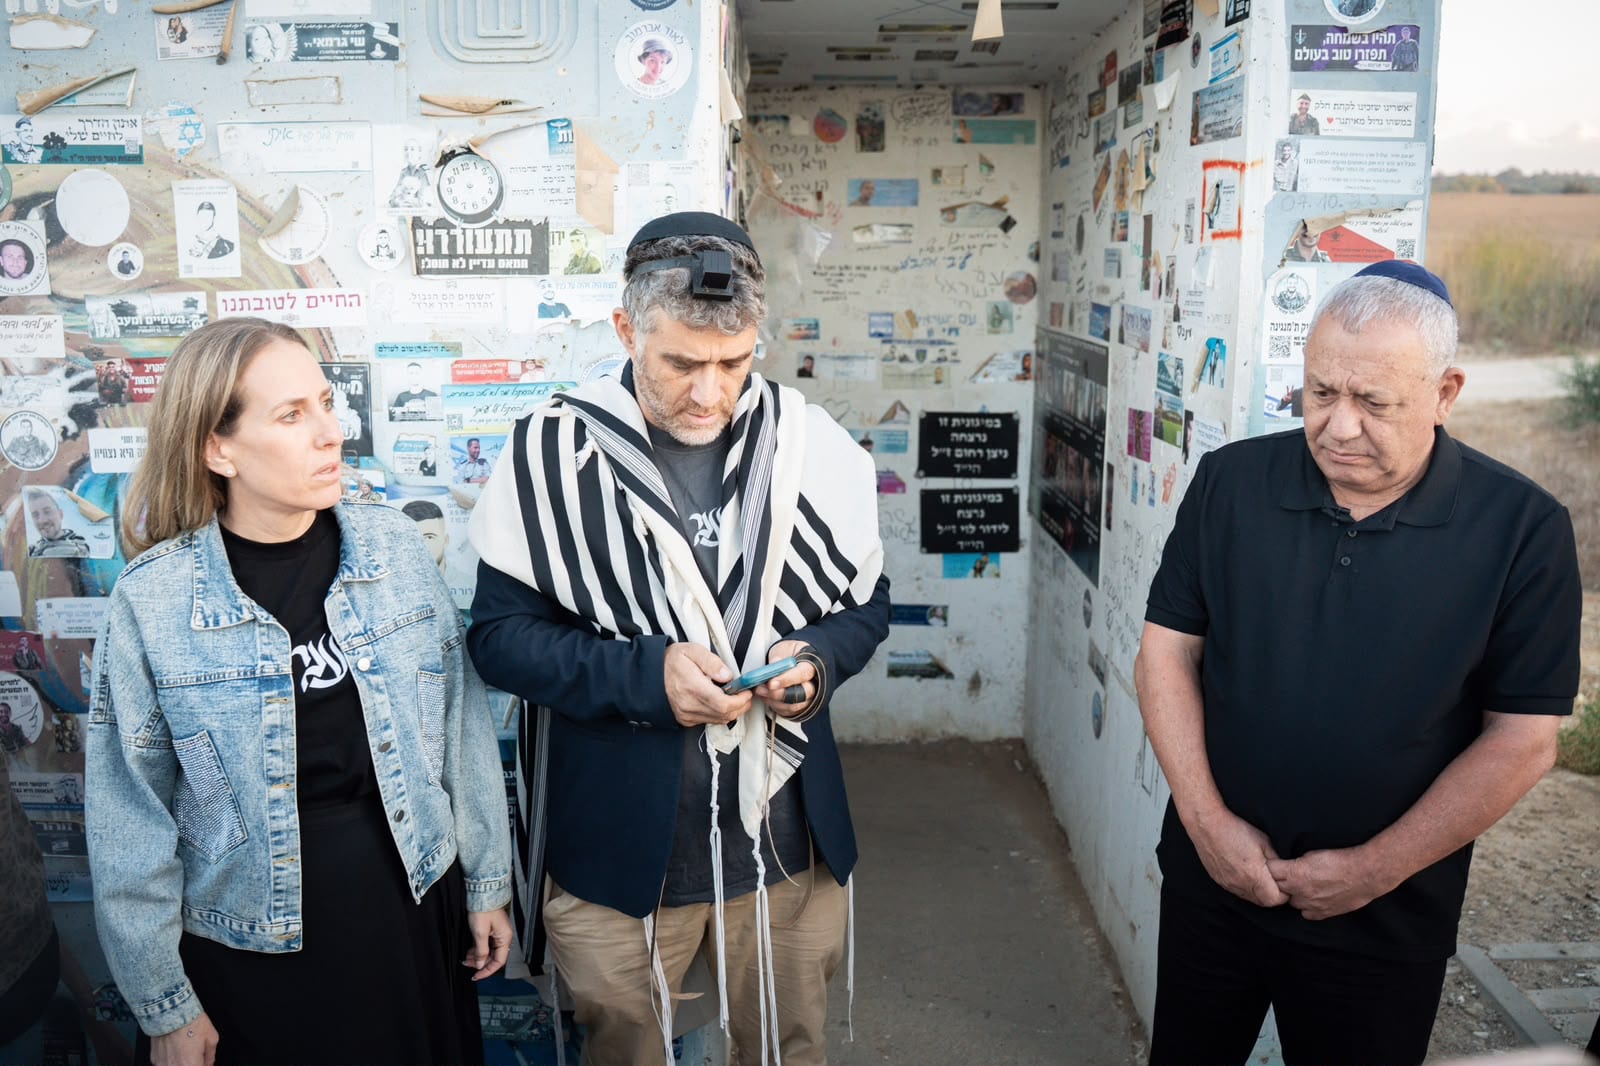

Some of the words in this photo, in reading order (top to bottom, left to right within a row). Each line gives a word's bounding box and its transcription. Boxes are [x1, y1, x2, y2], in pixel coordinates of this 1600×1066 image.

[350, 36, 366, 47] שי
[1323, 32, 1369, 46] בשמחה,
[1372, 32, 1396, 44] תהיו
[1294, 46, 1329, 60] בעולם
[1332, 49, 1352, 60] טוב
[1354, 49, 1386, 60] תפזרו
[78, 118, 110, 131] הדרך
[92, 126, 124, 141] לחיים
[452, 257, 466, 269] לא
[222, 292, 297, 312] לטובתנו
[306, 294, 360, 308] החיים
[938, 417, 949, 428] זו
[950, 432, 988, 443] נרצחה
[954, 448, 984, 458] רחום
[986, 448, 1009, 460] ניצן
[940, 494, 950, 504] זו
[956, 509, 985, 519] נרצח
[960, 523, 976, 534] לוי
[979, 522, 1010, 534] לידור
